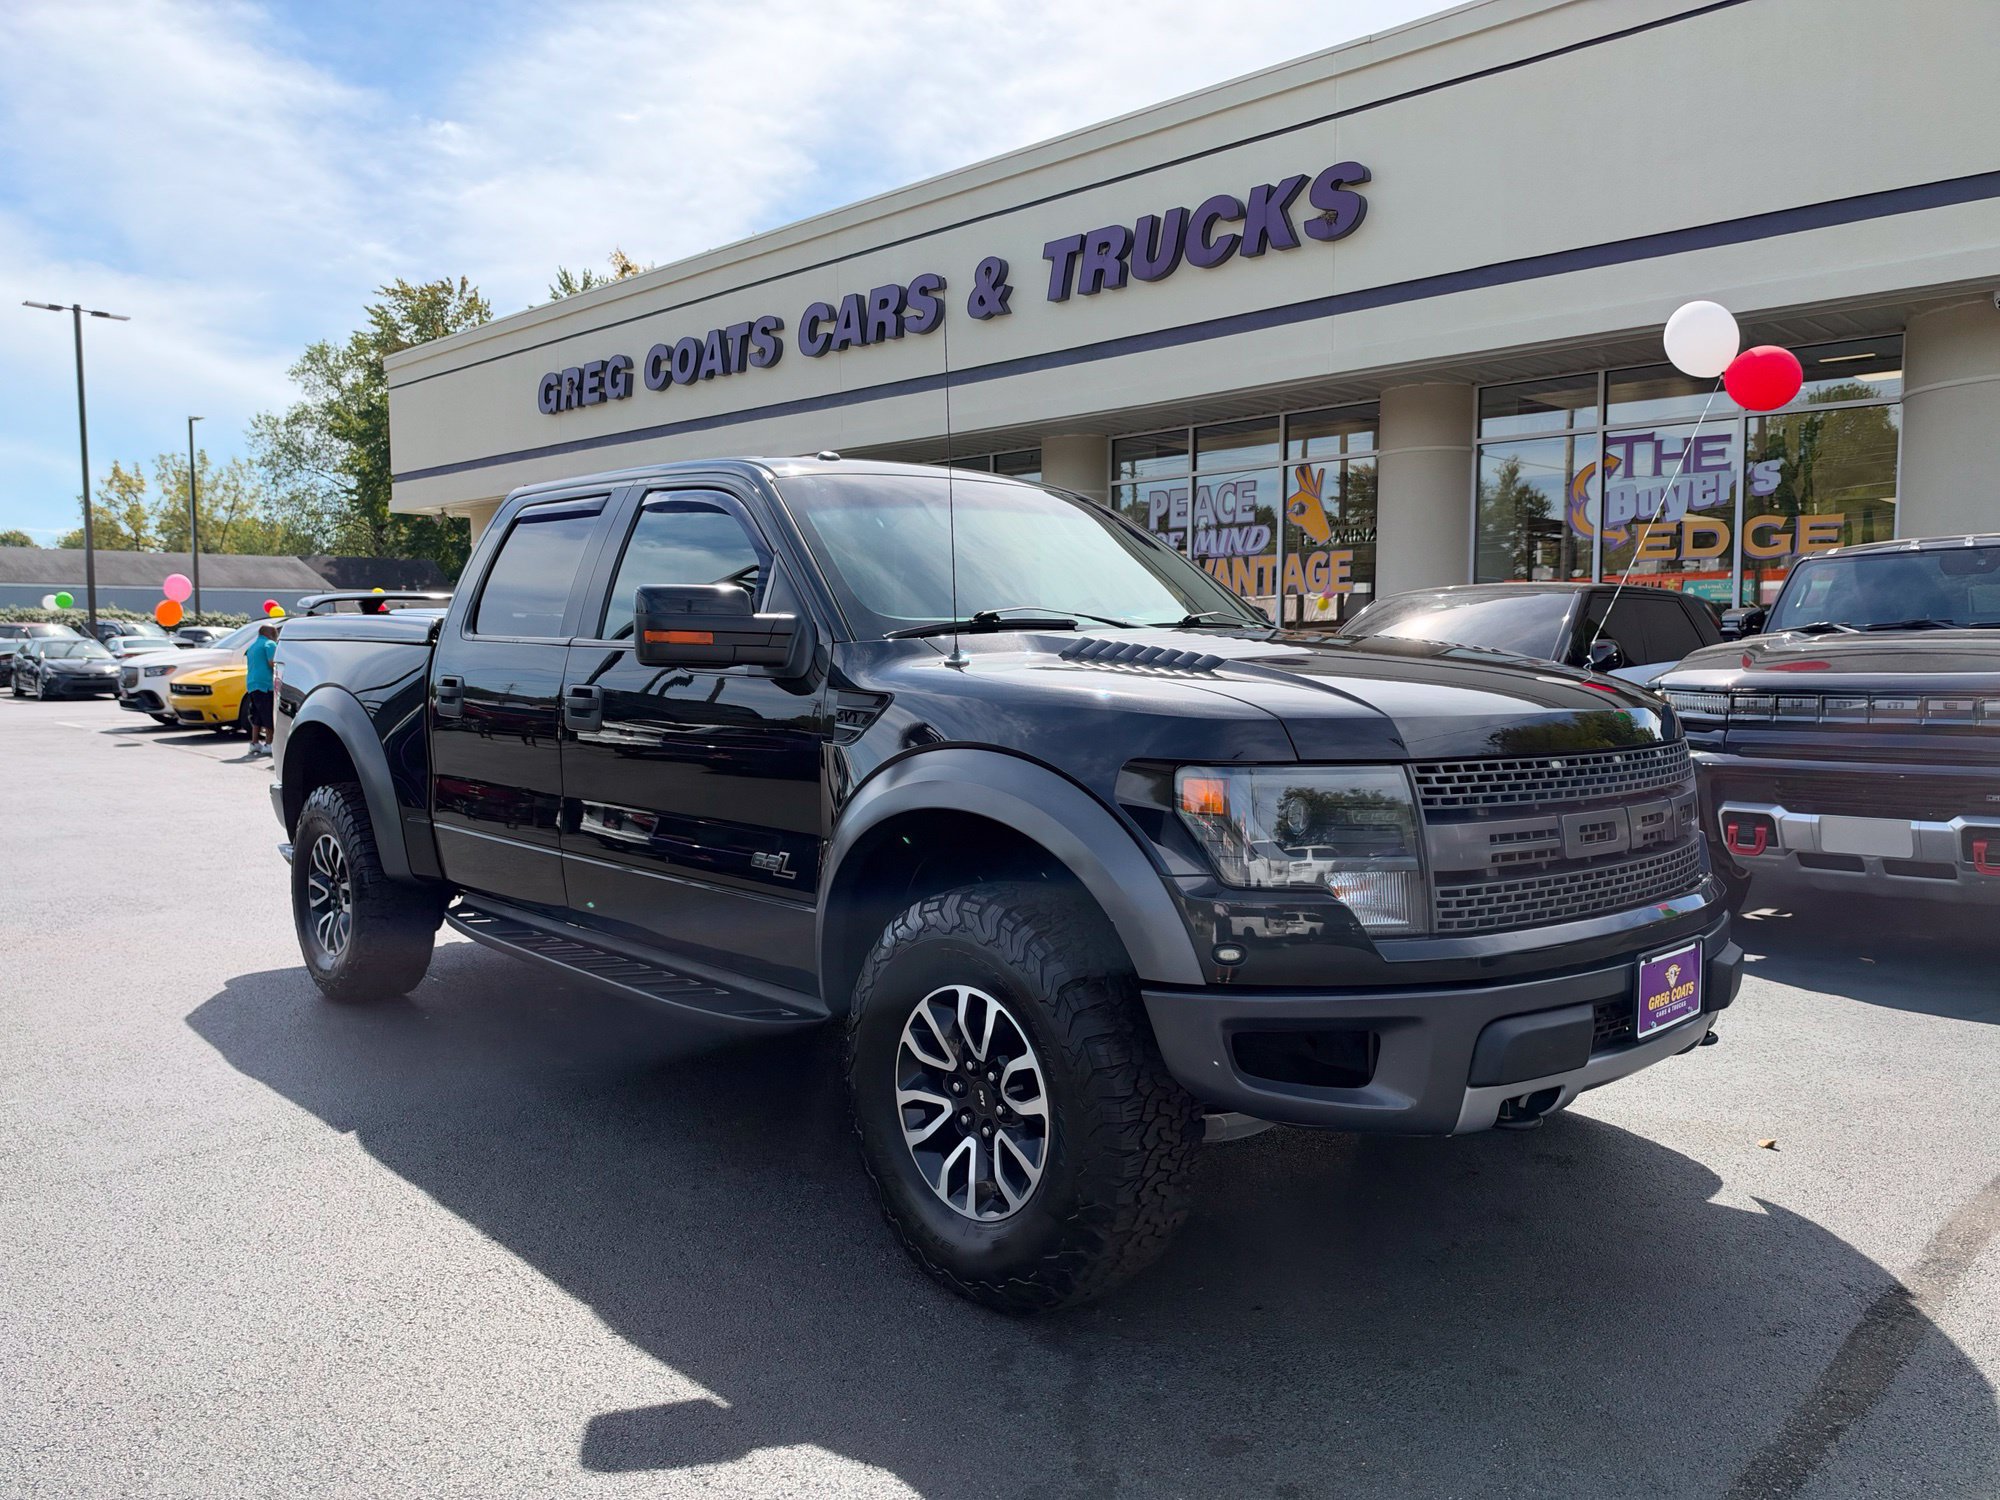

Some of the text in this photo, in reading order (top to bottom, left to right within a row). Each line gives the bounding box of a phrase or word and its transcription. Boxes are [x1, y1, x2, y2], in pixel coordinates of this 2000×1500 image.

[537, 161, 1372, 415] GREG COATS CARS & TRUCKS
[1606, 431, 1732, 478] THE
[1149, 480, 1257, 530] PEACE
[1193, 524, 1271, 559] MIND
[1636, 512, 1845, 560] EDGE
[1427, 791, 1698, 872] FORD
[1648, 981, 1694, 1011] GREG COATS
[1656, 1008, 1667, 1018] CARS
